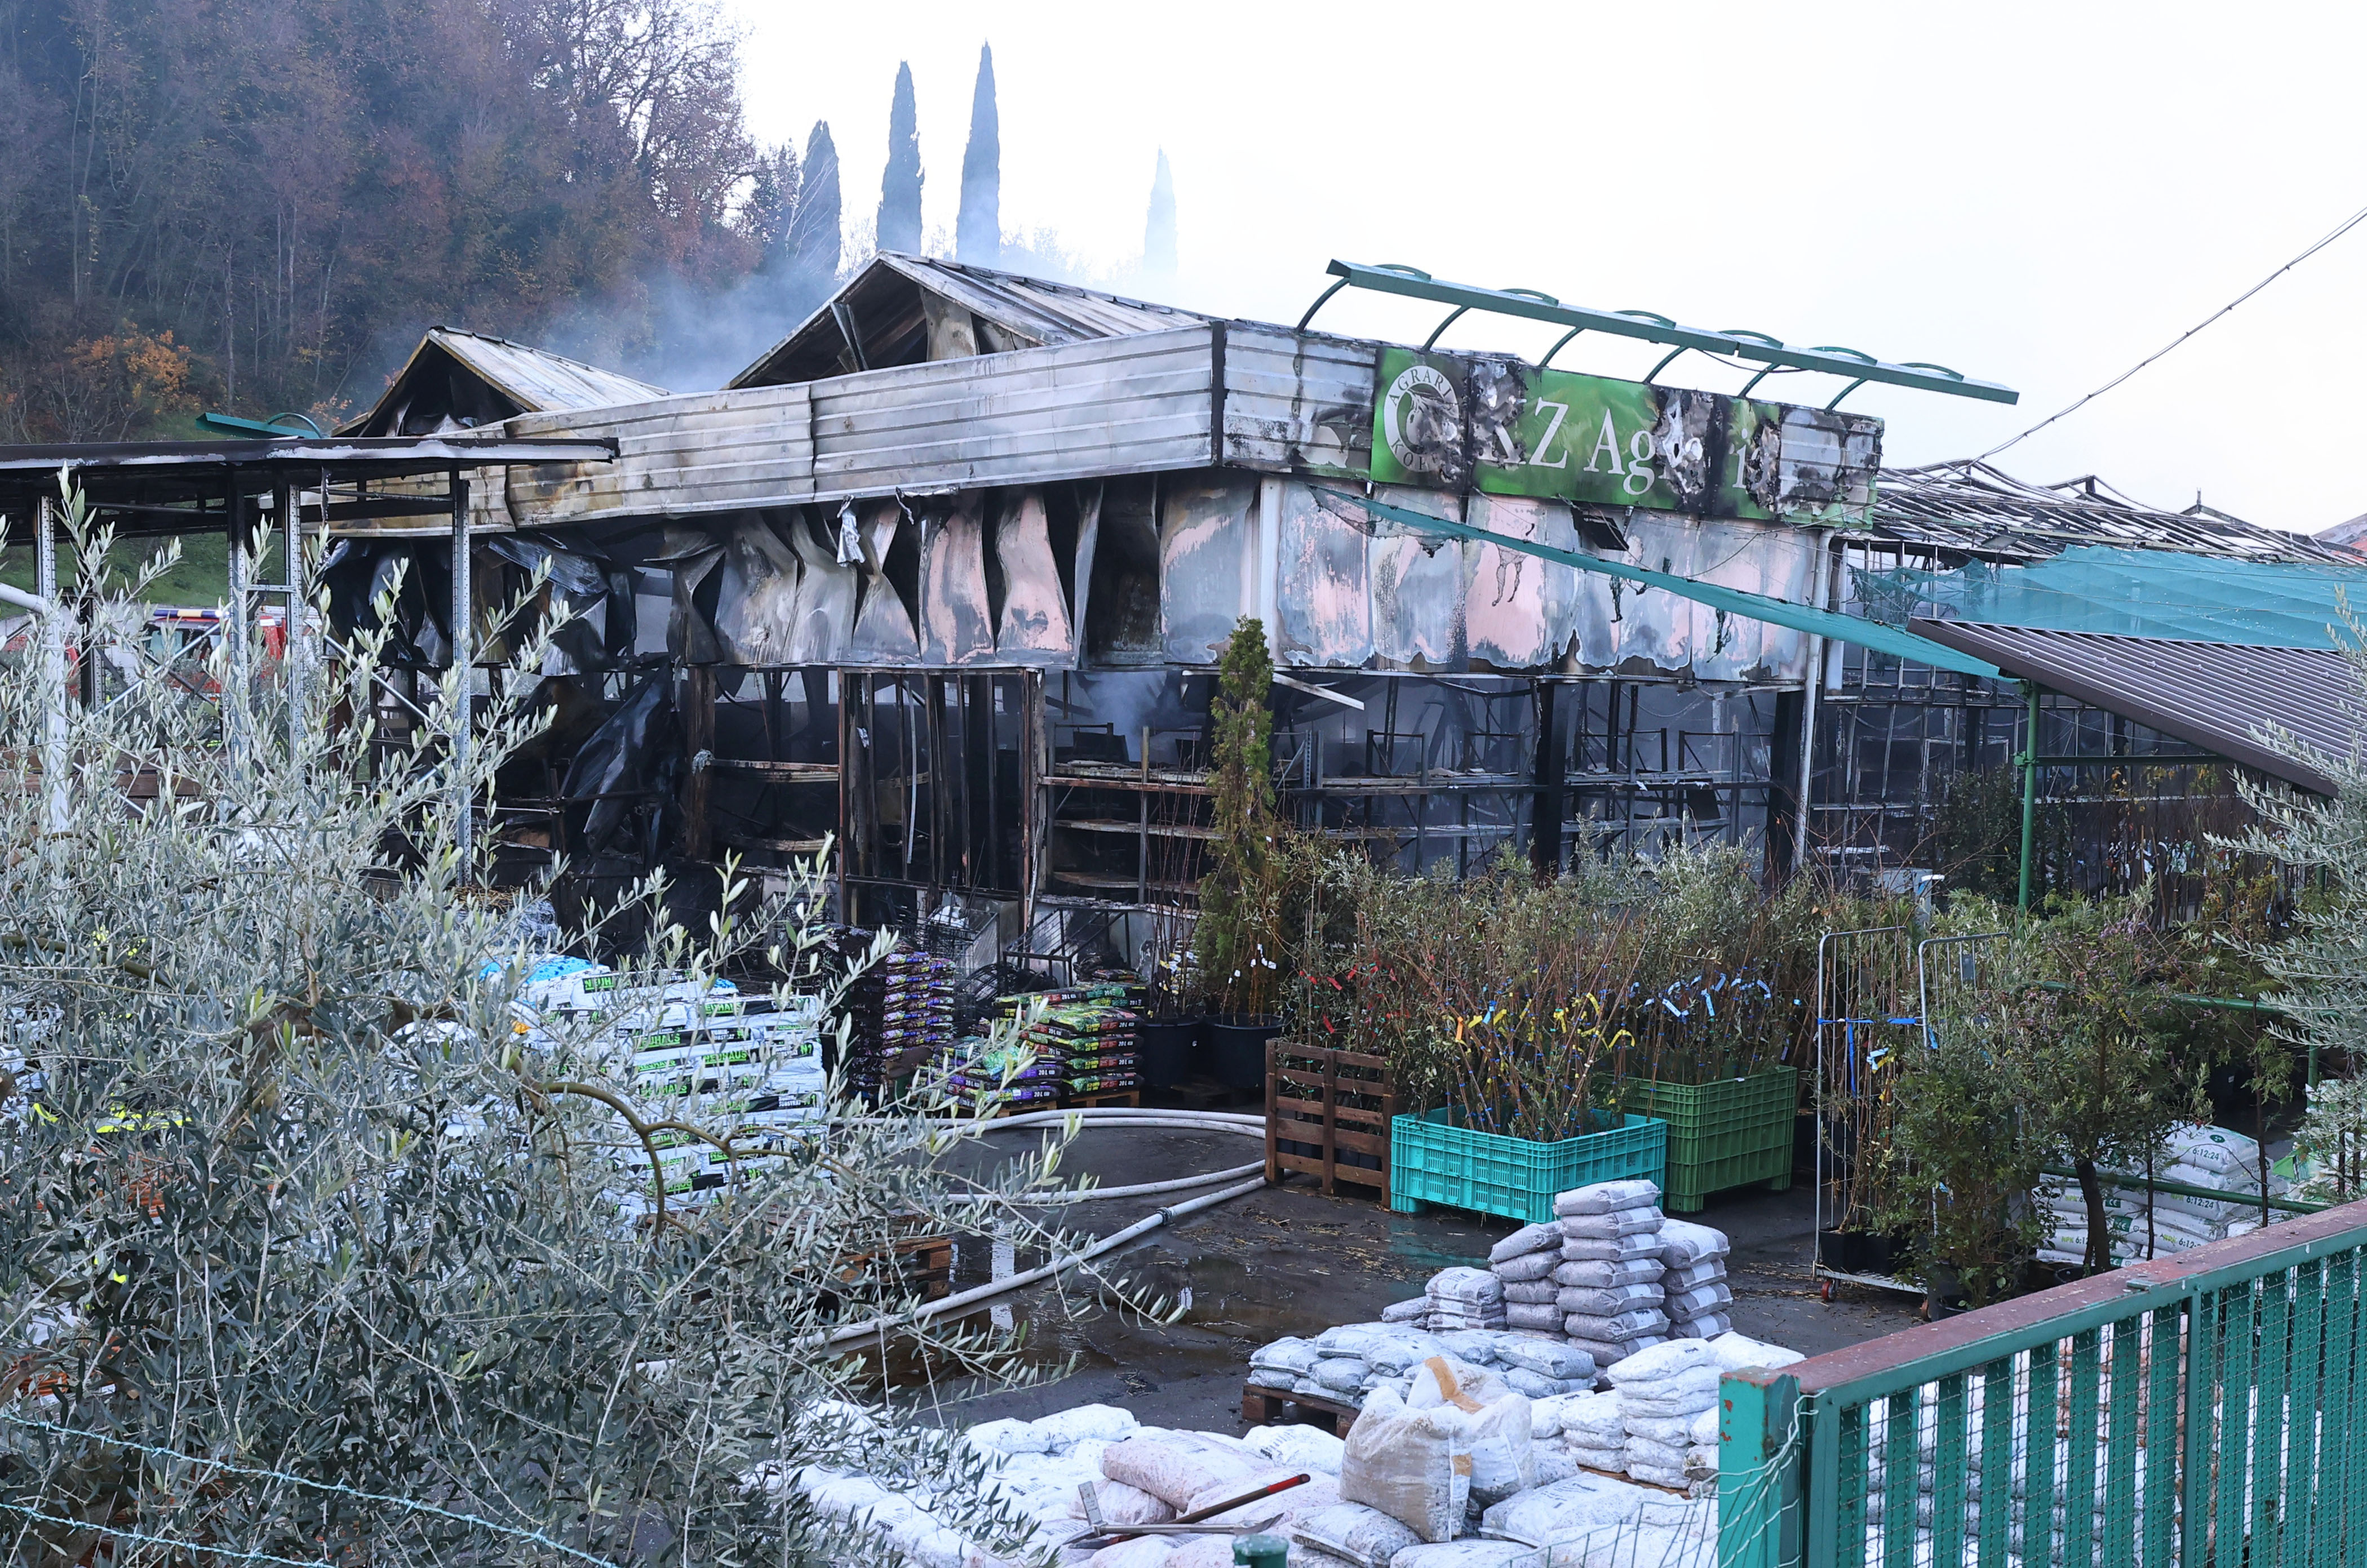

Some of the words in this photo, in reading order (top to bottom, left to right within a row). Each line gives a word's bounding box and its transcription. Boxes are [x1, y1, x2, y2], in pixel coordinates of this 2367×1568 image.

[1389, 368, 1455, 409] AGRARI
[2192, 1147, 2219, 1161] 6:12:24
[2186, 1196, 2214, 1209] 6:12:24
